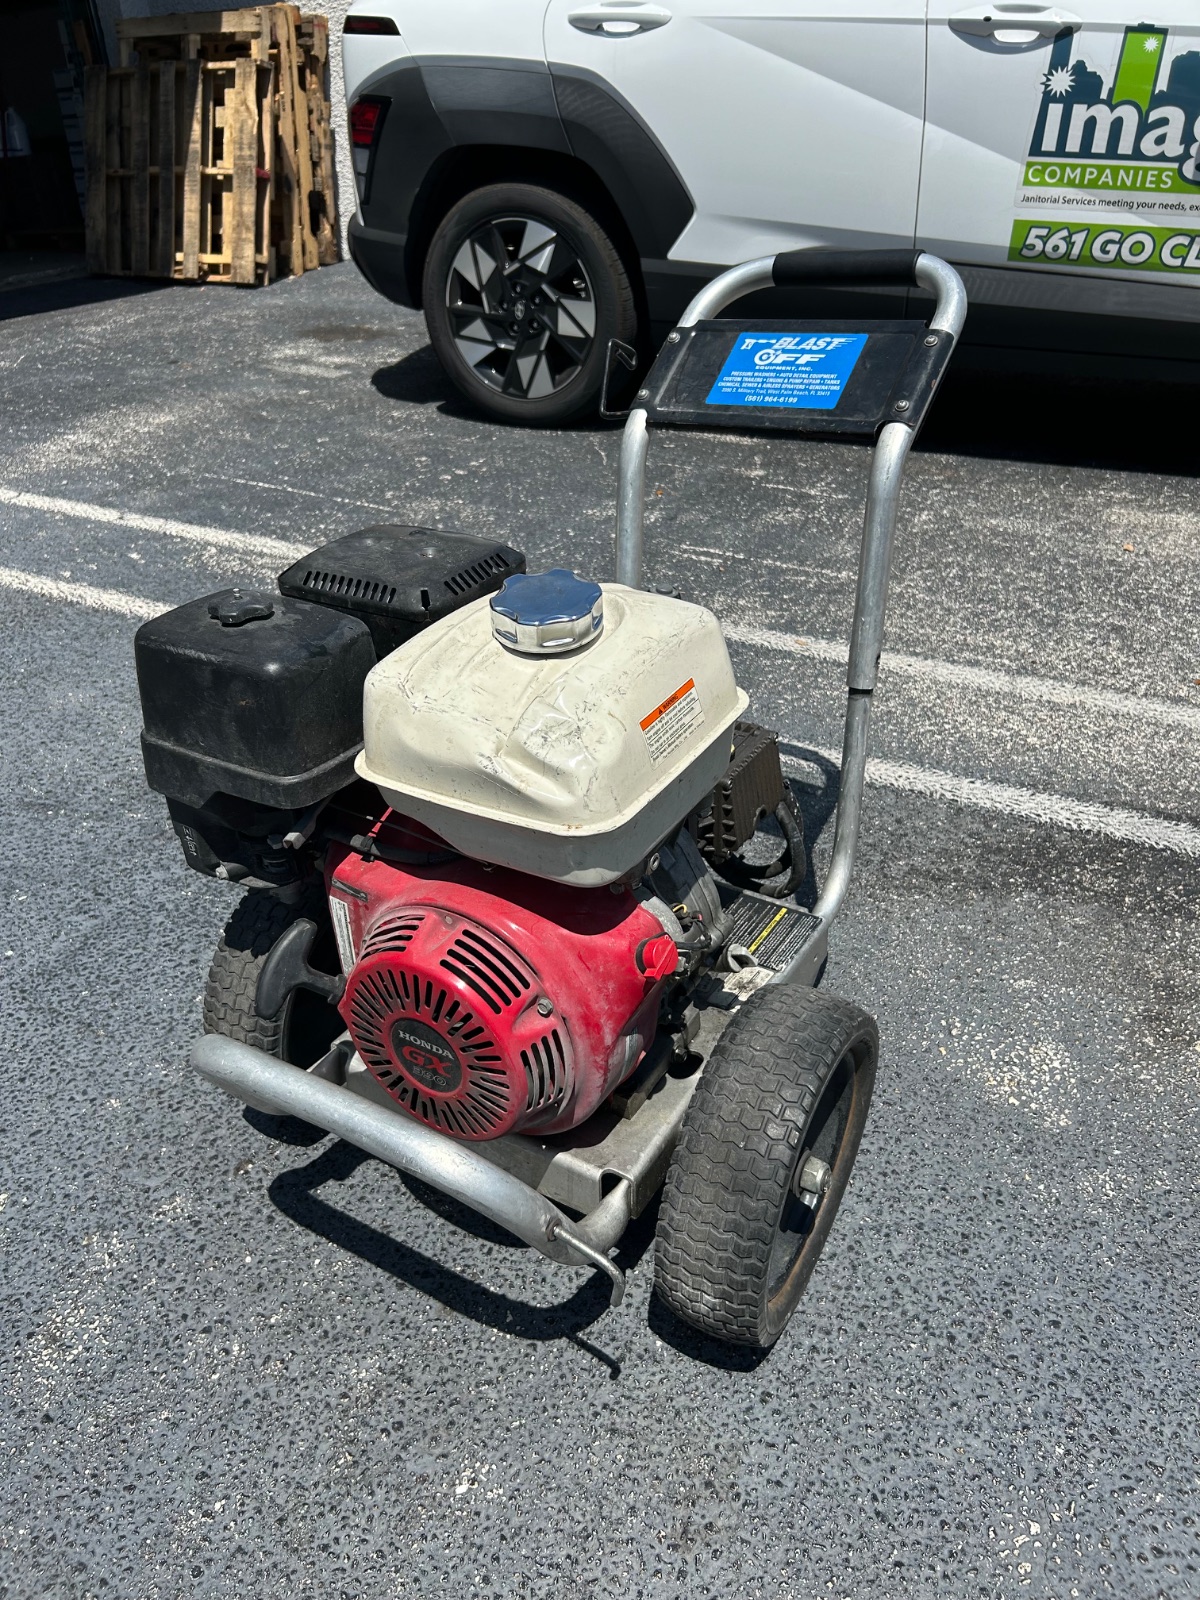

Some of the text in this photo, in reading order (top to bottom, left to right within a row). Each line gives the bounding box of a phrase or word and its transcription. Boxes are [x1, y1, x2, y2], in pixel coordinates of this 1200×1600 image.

[1028, 165, 1173, 188] COMPANIES
[1021, 194, 1060, 205] Janitorial
[1062, 196, 1096, 206] Services
[1098, 198, 1134, 209] meeting
[1136, 200, 1156, 210] your
[1158, 202, 1187, 212] needs,
[1020, 227, 1090, 261] 561
[1090, 230, 1154, 265] GO
[774, 337, 852, 350] BLAST
[754, 349, 826, 365] OFF
[663, 694, 678, 710] WARNING
[398, 1030, 454, 1060] HONDA
[402, 1045, 452, 1078] GX
